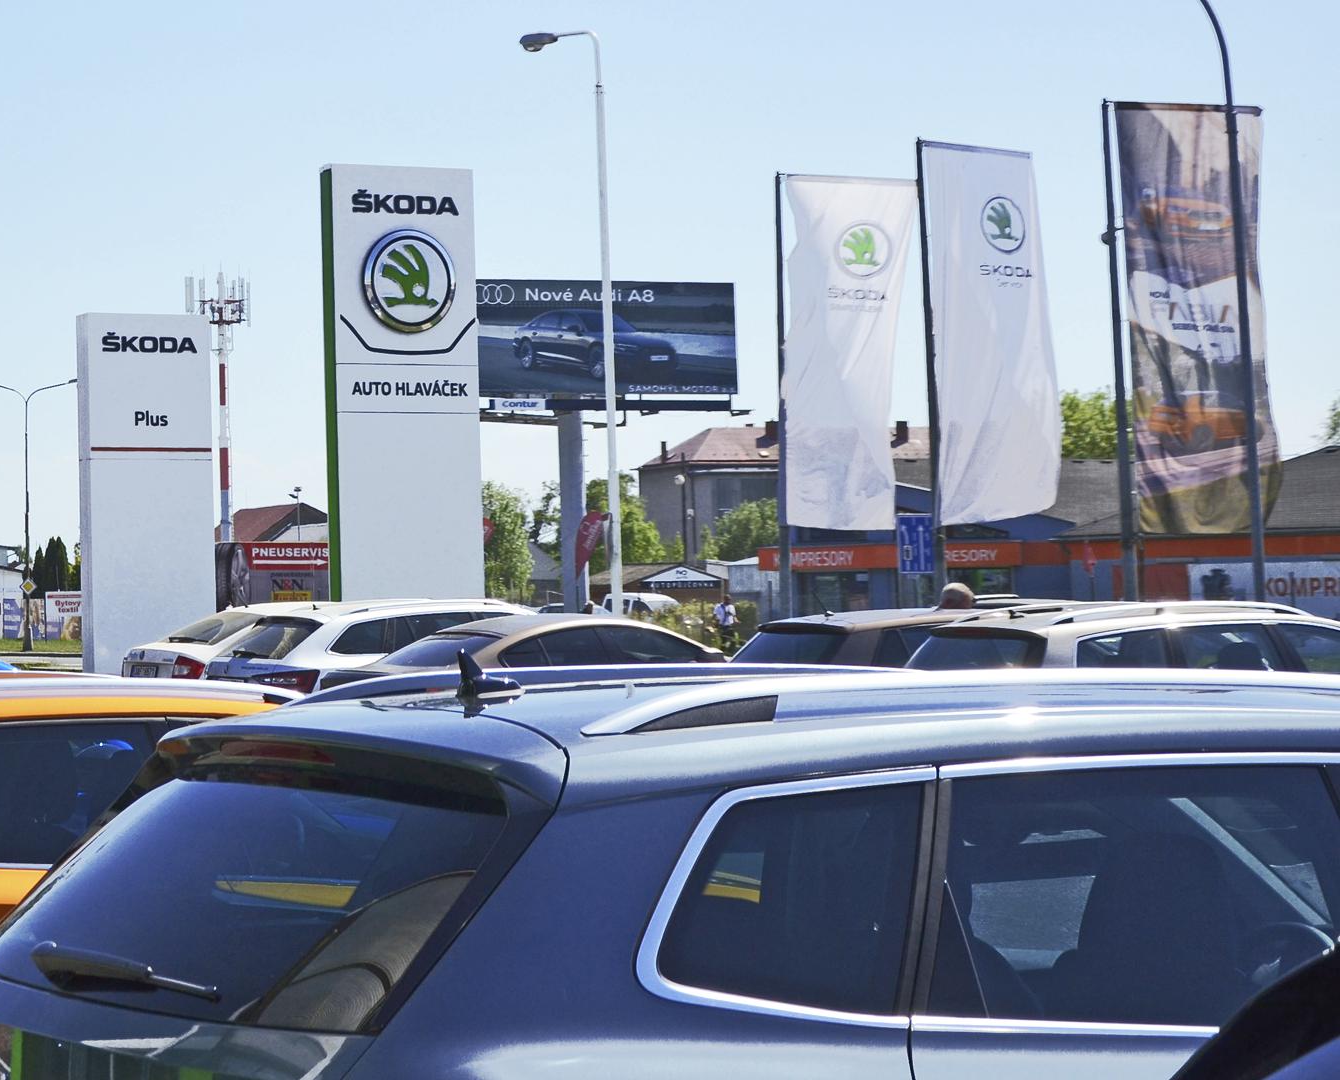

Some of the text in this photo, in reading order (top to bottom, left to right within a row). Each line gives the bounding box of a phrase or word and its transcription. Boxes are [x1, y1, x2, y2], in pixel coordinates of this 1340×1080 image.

[352, 189, 459, 216] ŠKODA
[525, 287, 573, 302] Nové
[627, 289, 655, 303] A8
[102, 331, 197, 354] ŠKODA
[352, 379, 468, 397] AUTO HLAVÁČEK
[134, 410, 168, 427] Plus
[252, 547, 329, 557] PNEUSERVIS
[773, 551, 854, 567] KMPRESORY
[944, 549, 998, 562] RESORY
[1265, 577, 1340, 597] KOMPR
